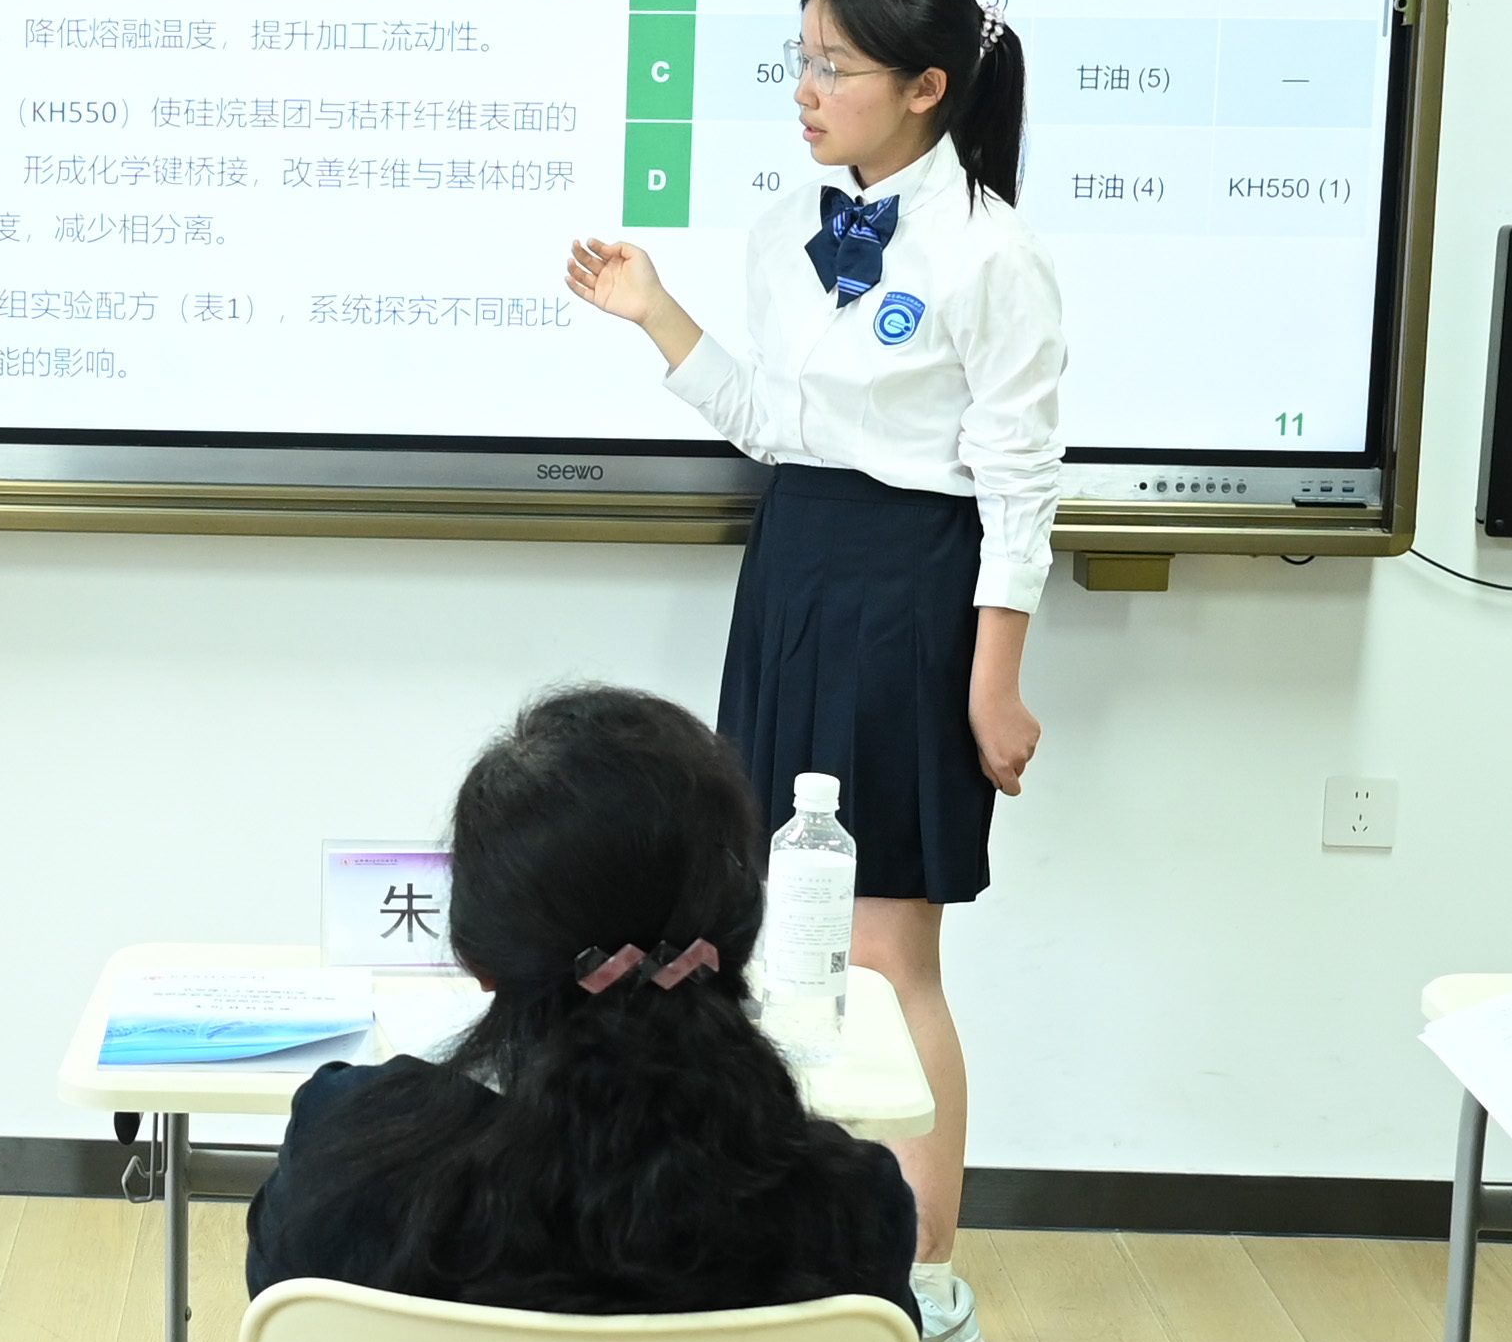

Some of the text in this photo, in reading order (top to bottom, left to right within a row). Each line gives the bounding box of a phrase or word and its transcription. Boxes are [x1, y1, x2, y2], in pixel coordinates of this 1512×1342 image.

[650, 60, 670, 83] C
[755, 61, 784, 85] 50
[1076, 64, 1170, 94] 甘油 (5)
[647, 168, 667, 191] D
[751, 170, 781, 192] 40
[1071, 173, 1164, 203] 甘油 (4)
[1228, 177, 1351, 204] KH550 (1)
[1275, 412, 1304, 437] 11
[536, 463, 604, 481] seewo
[379, 882, 441, 943] 朱
